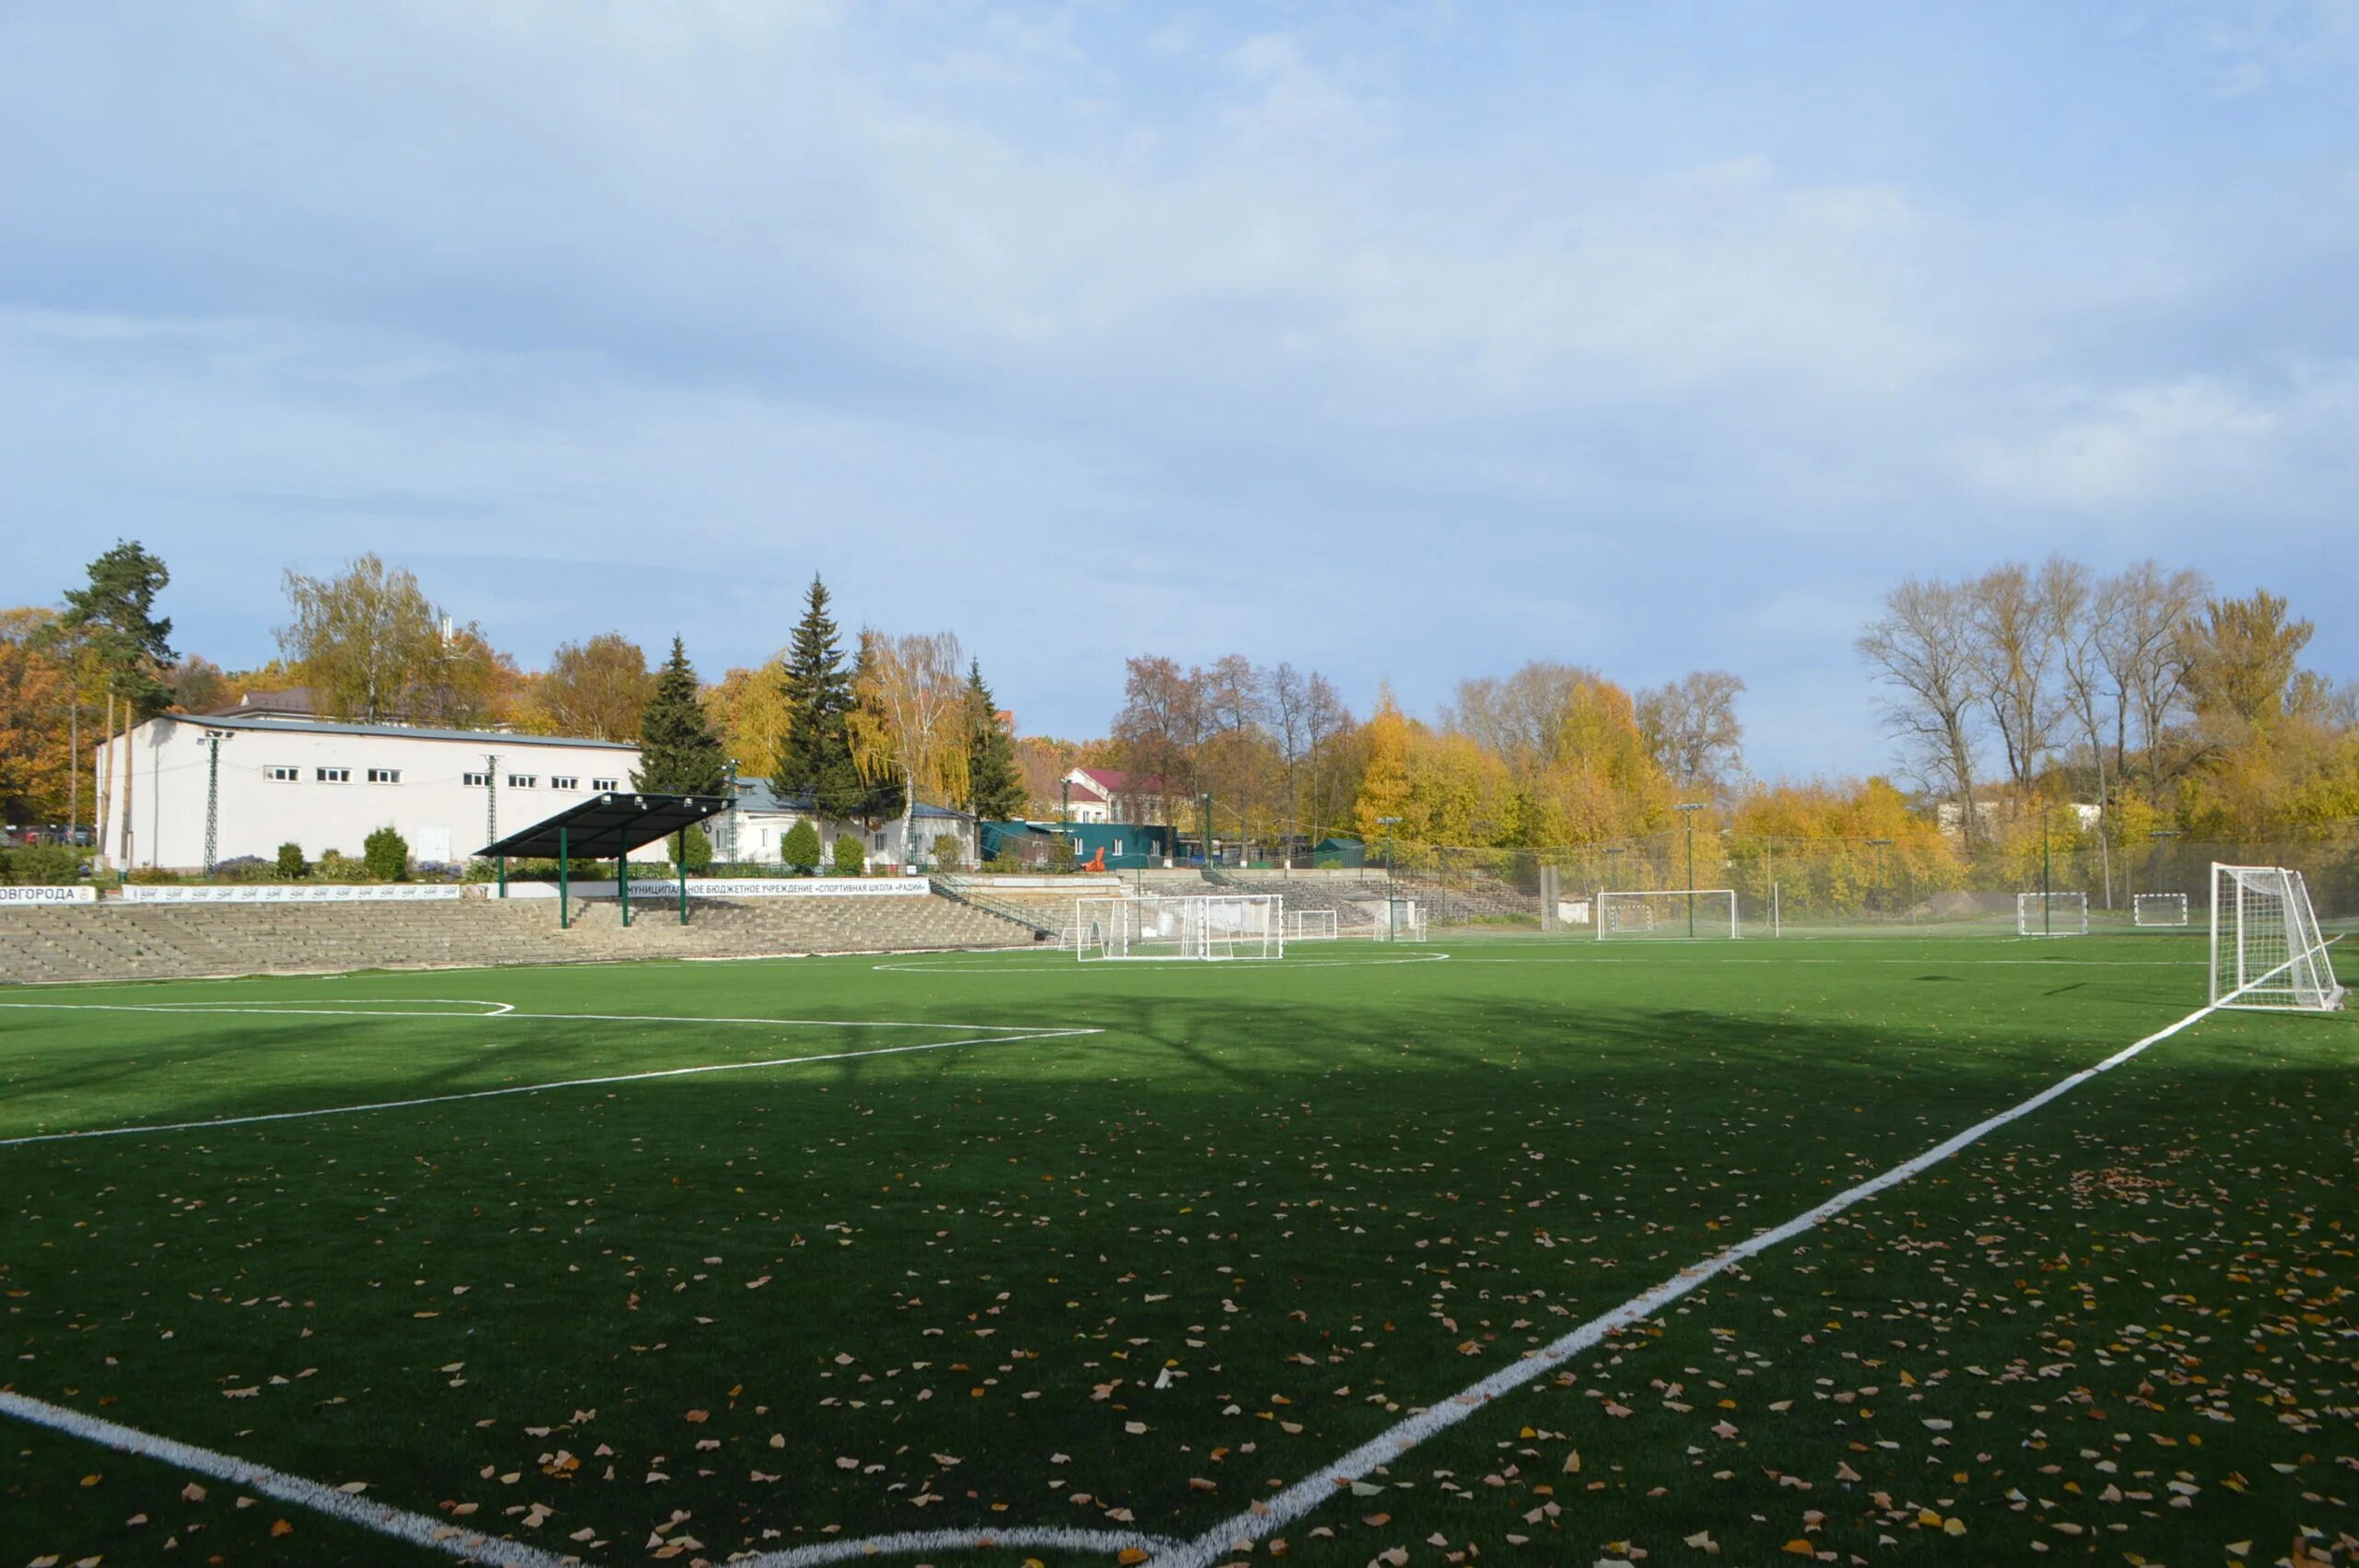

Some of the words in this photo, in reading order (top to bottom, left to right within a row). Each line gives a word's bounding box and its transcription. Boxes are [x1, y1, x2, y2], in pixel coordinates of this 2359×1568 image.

[0, 888, 74, 900] ОВГОРОДА
[706, 883, 759, 894] БЮДЖЕТНОЕ
[762, 883, 813, 894] УЧРЕЖДЕНИЕ
[815, 883, 867, 893] «СПОРТИВНАЯ
[869, 883, 893, 892] ШКОЛА
[895, 882, 925, 891] «РАДИЙ»
